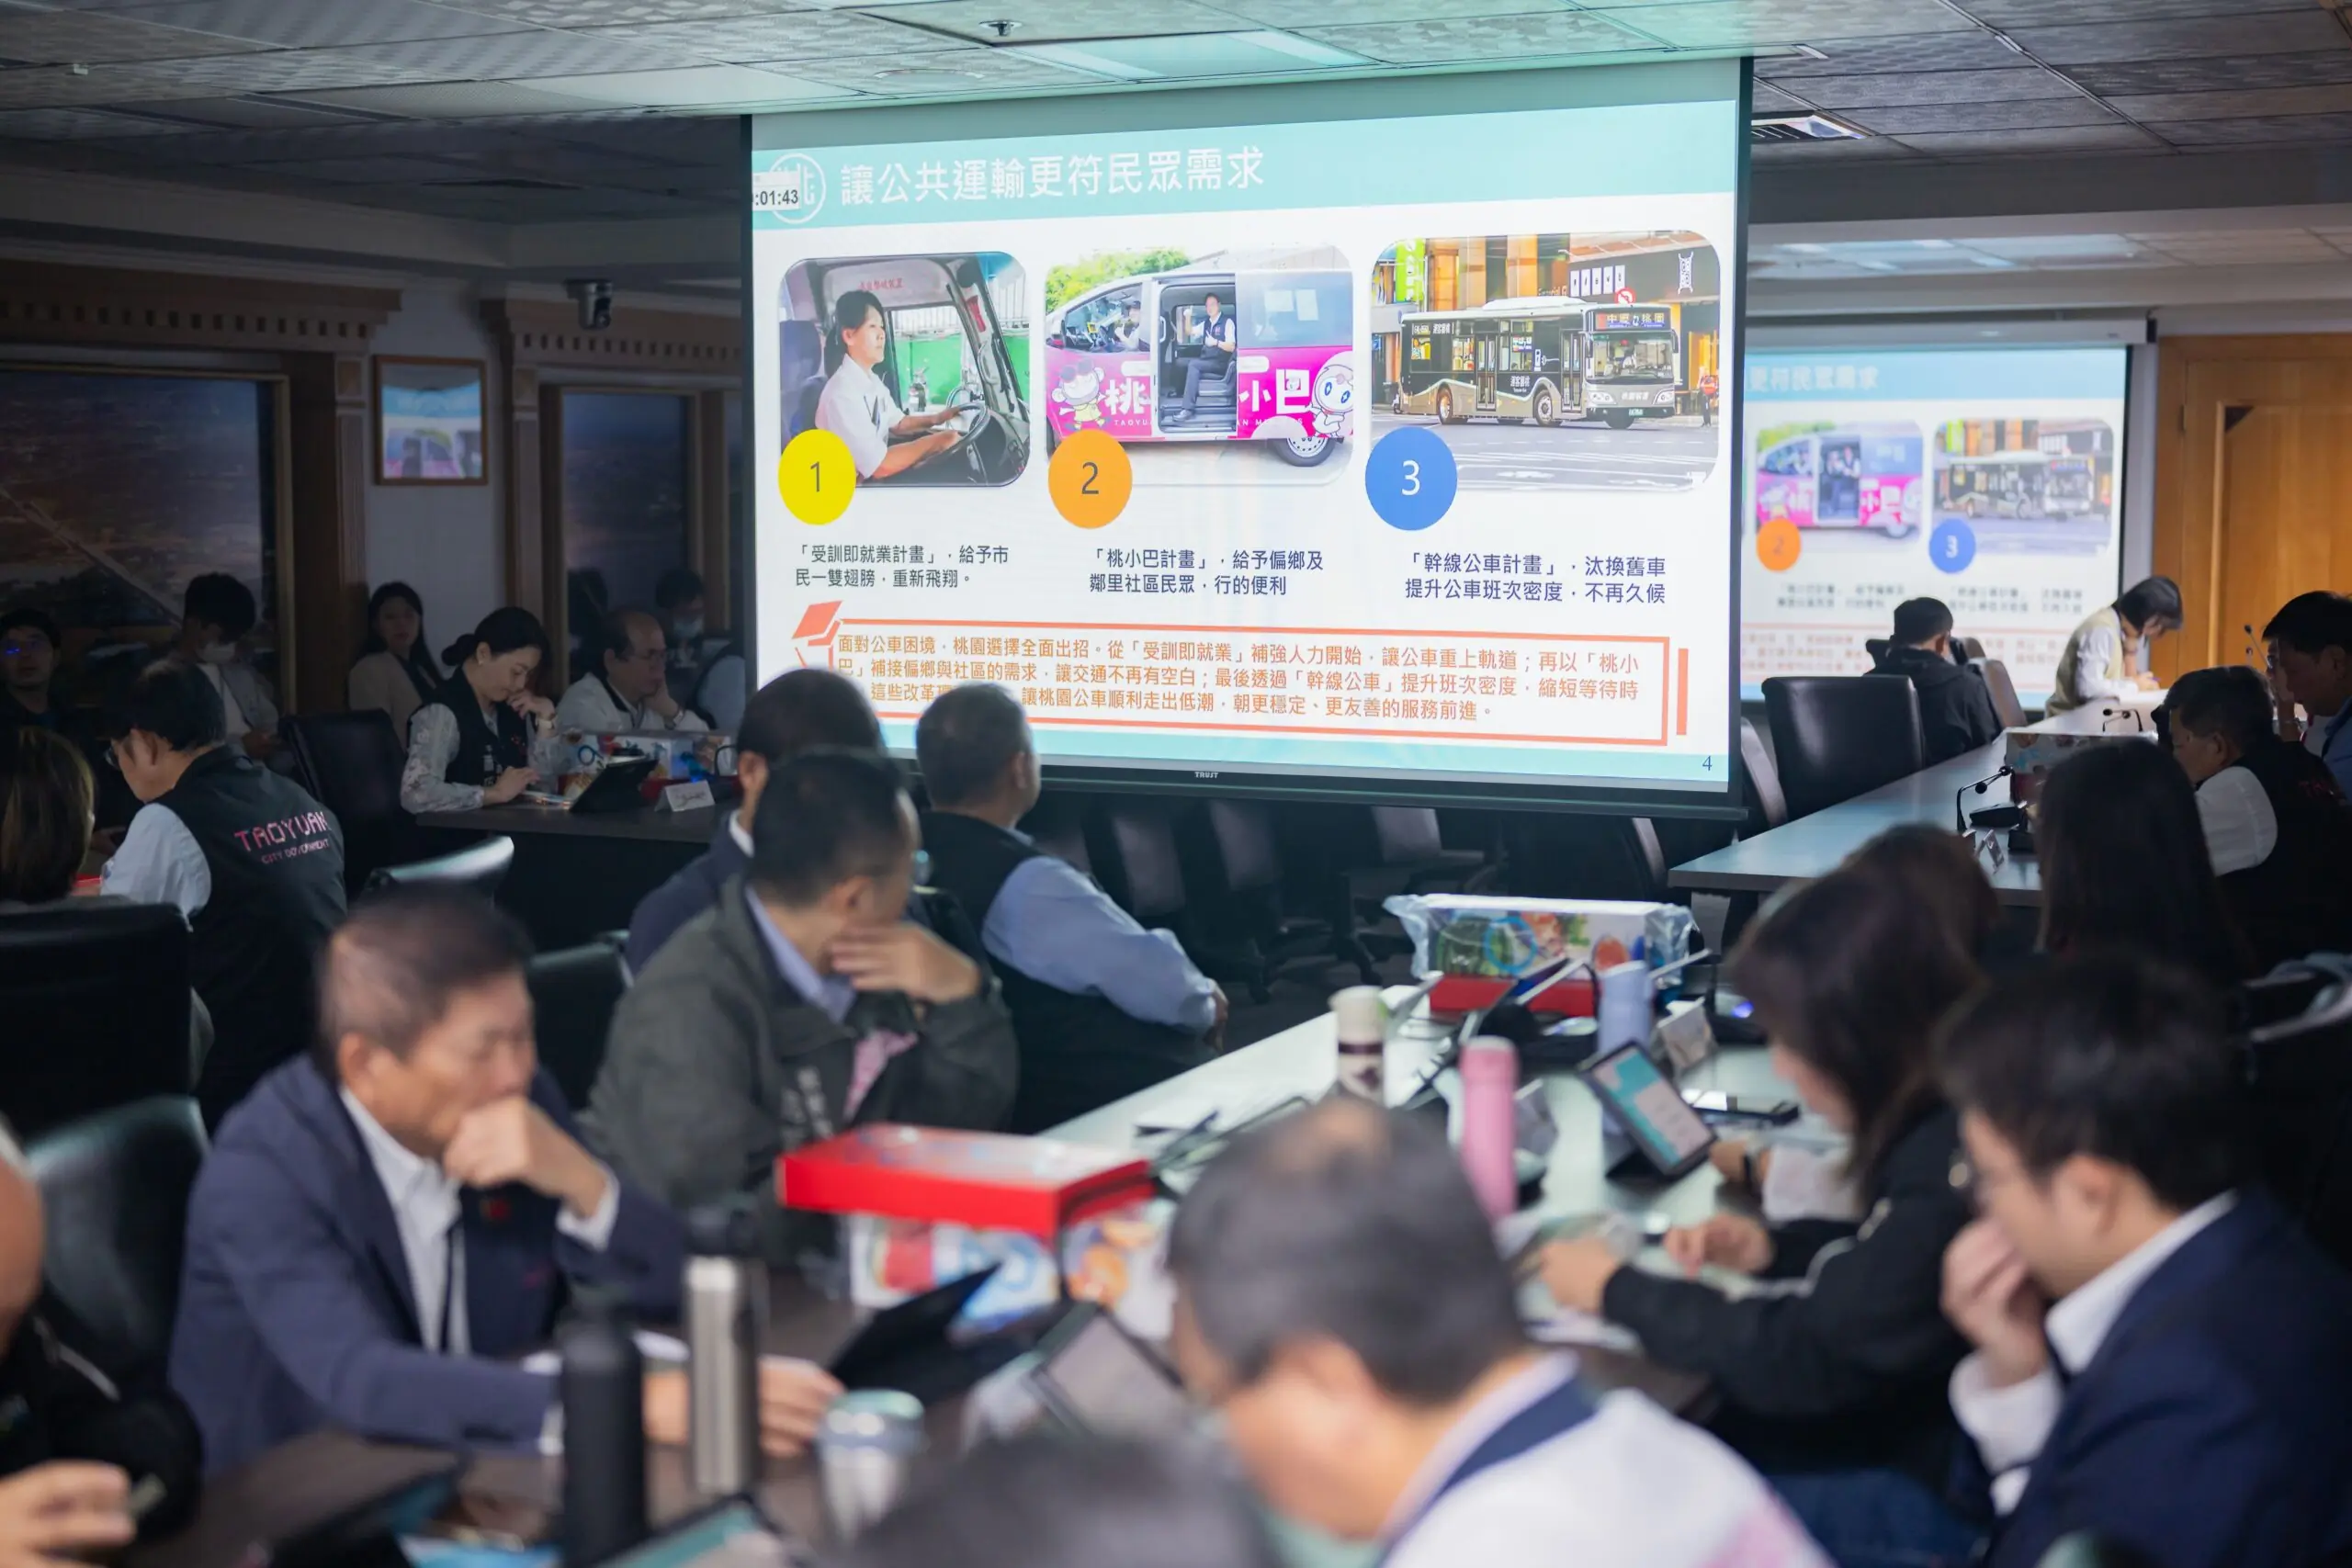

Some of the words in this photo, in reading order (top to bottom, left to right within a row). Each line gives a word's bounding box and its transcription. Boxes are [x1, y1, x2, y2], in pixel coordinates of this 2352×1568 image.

[840, 145, 1264, 206] 讓公共運輸更符民眾需求
[752, 189, 798, 207] :01:43
[810, 461, 820, 493] 1
[1081, 461, 1099, 495] 2
[1401, 459, 1420, 496] 3
[1194, 771, 1219, 779] TRUST
[1702, 755, 1713, 771] 4
[234, 811, 330, 852] TAOYUAN
